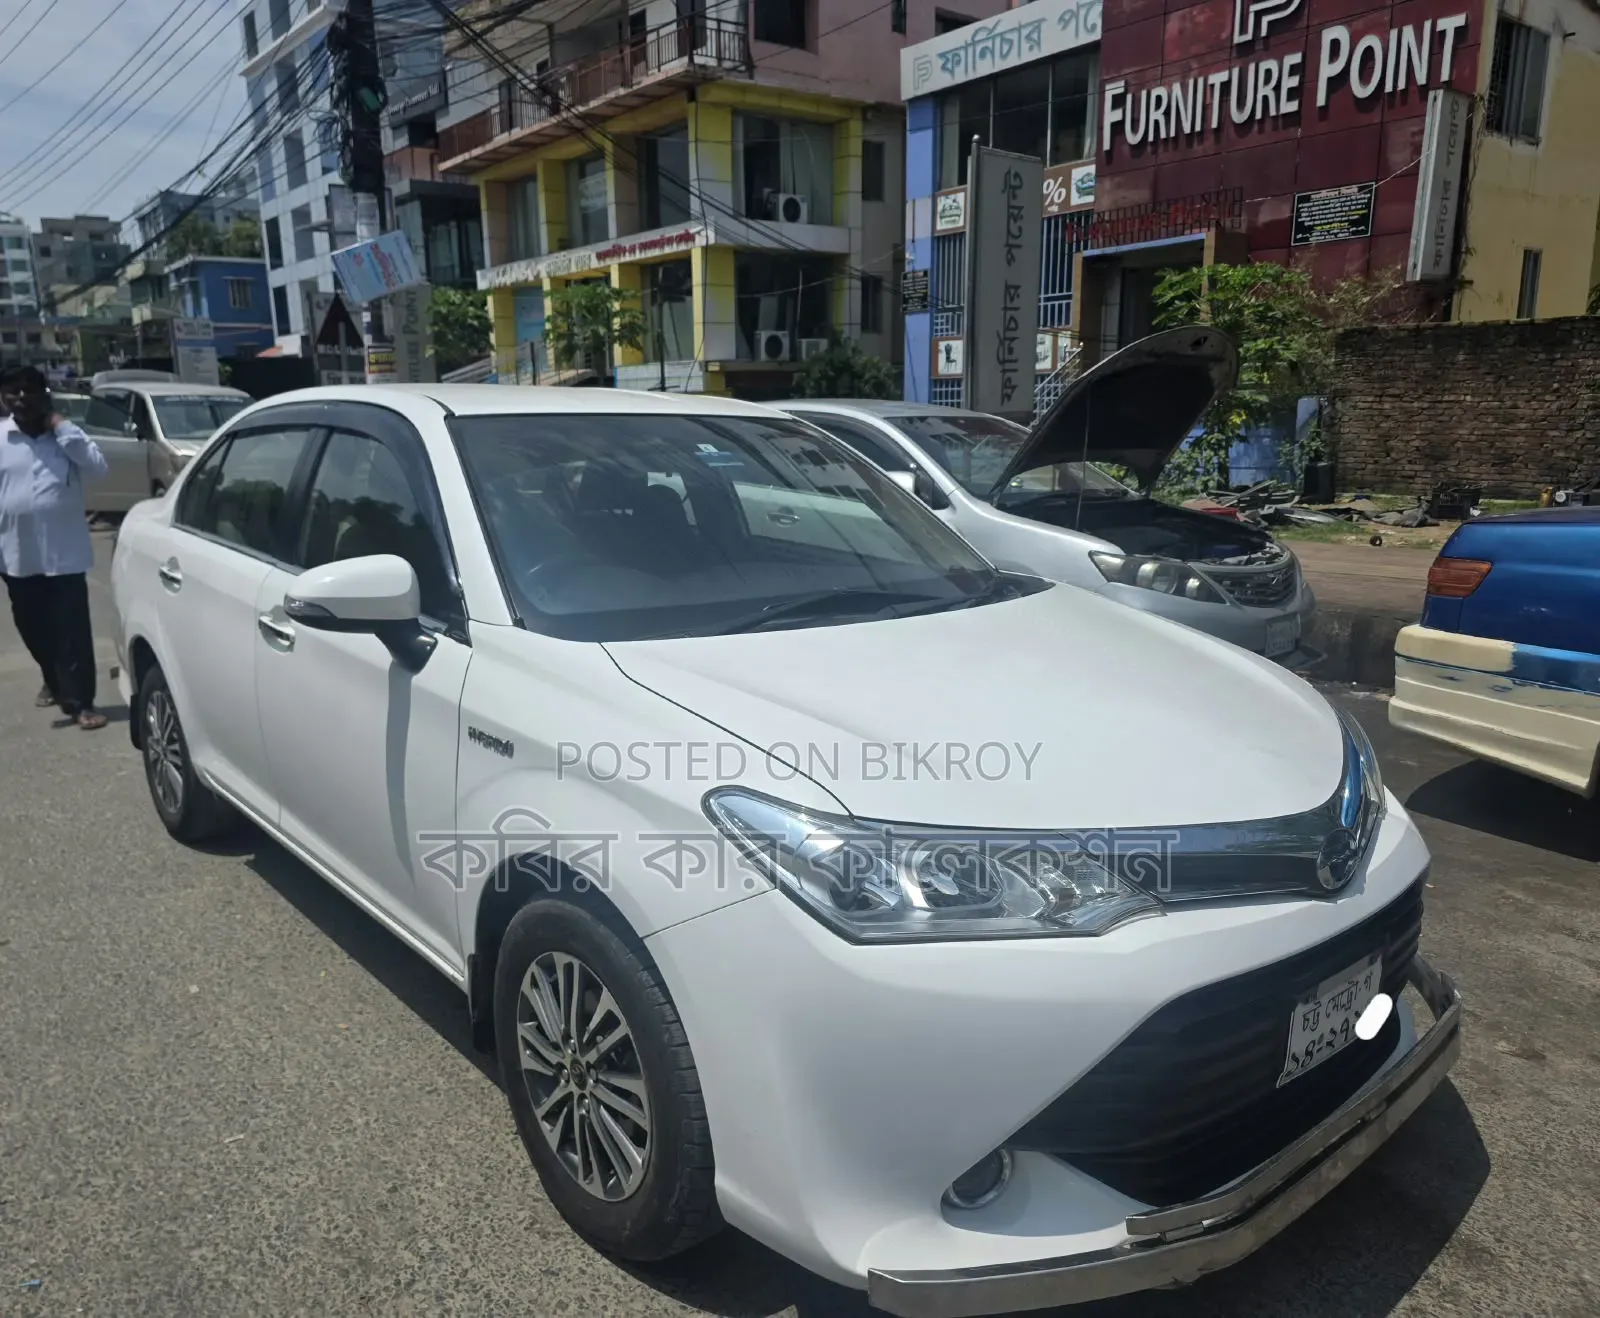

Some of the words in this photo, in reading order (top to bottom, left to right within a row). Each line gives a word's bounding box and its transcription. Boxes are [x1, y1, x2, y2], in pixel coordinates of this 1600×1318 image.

[937, 18, 1048, 81] ফার্নিচার
[1102, 51, 1303, 152] FURNITURE
[1316, 13, 1468, 108] POINT
[1001, 165, 1025, 268] পয়েন্ট
[996, 279, 1022, 407] ফার্নিচার
